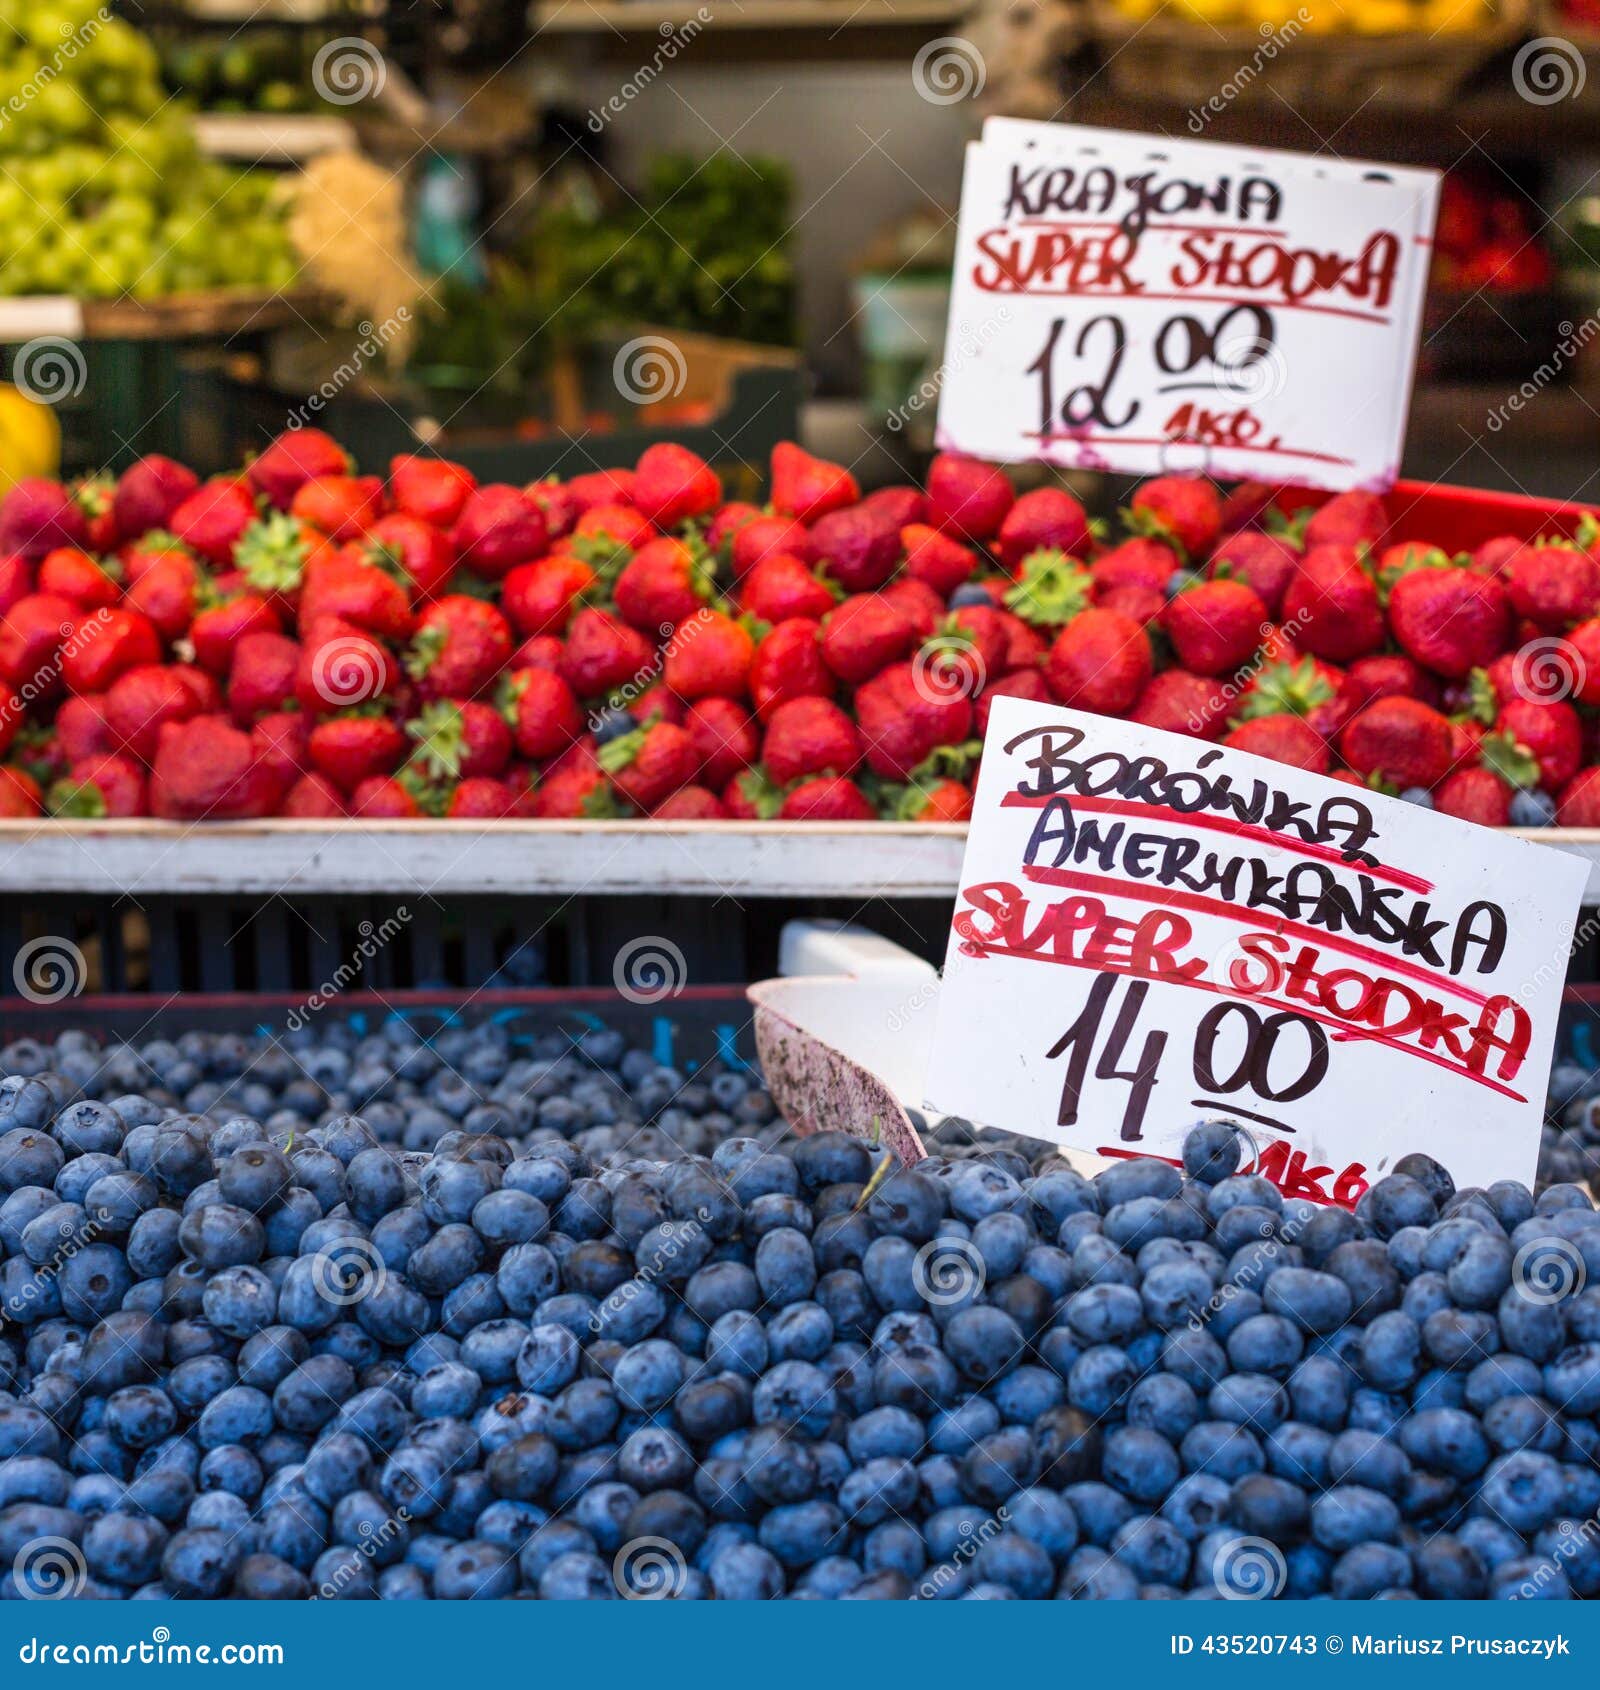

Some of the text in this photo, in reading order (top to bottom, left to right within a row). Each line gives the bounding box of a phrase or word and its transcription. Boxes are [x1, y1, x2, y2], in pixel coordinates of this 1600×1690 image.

[972, 229, 1146, 294] SUPER
[1026, 314, 1140, 433] 12
[953, 881, 1208, 980] SUPER
[1046, 971, 1330, 1141] 14 00
